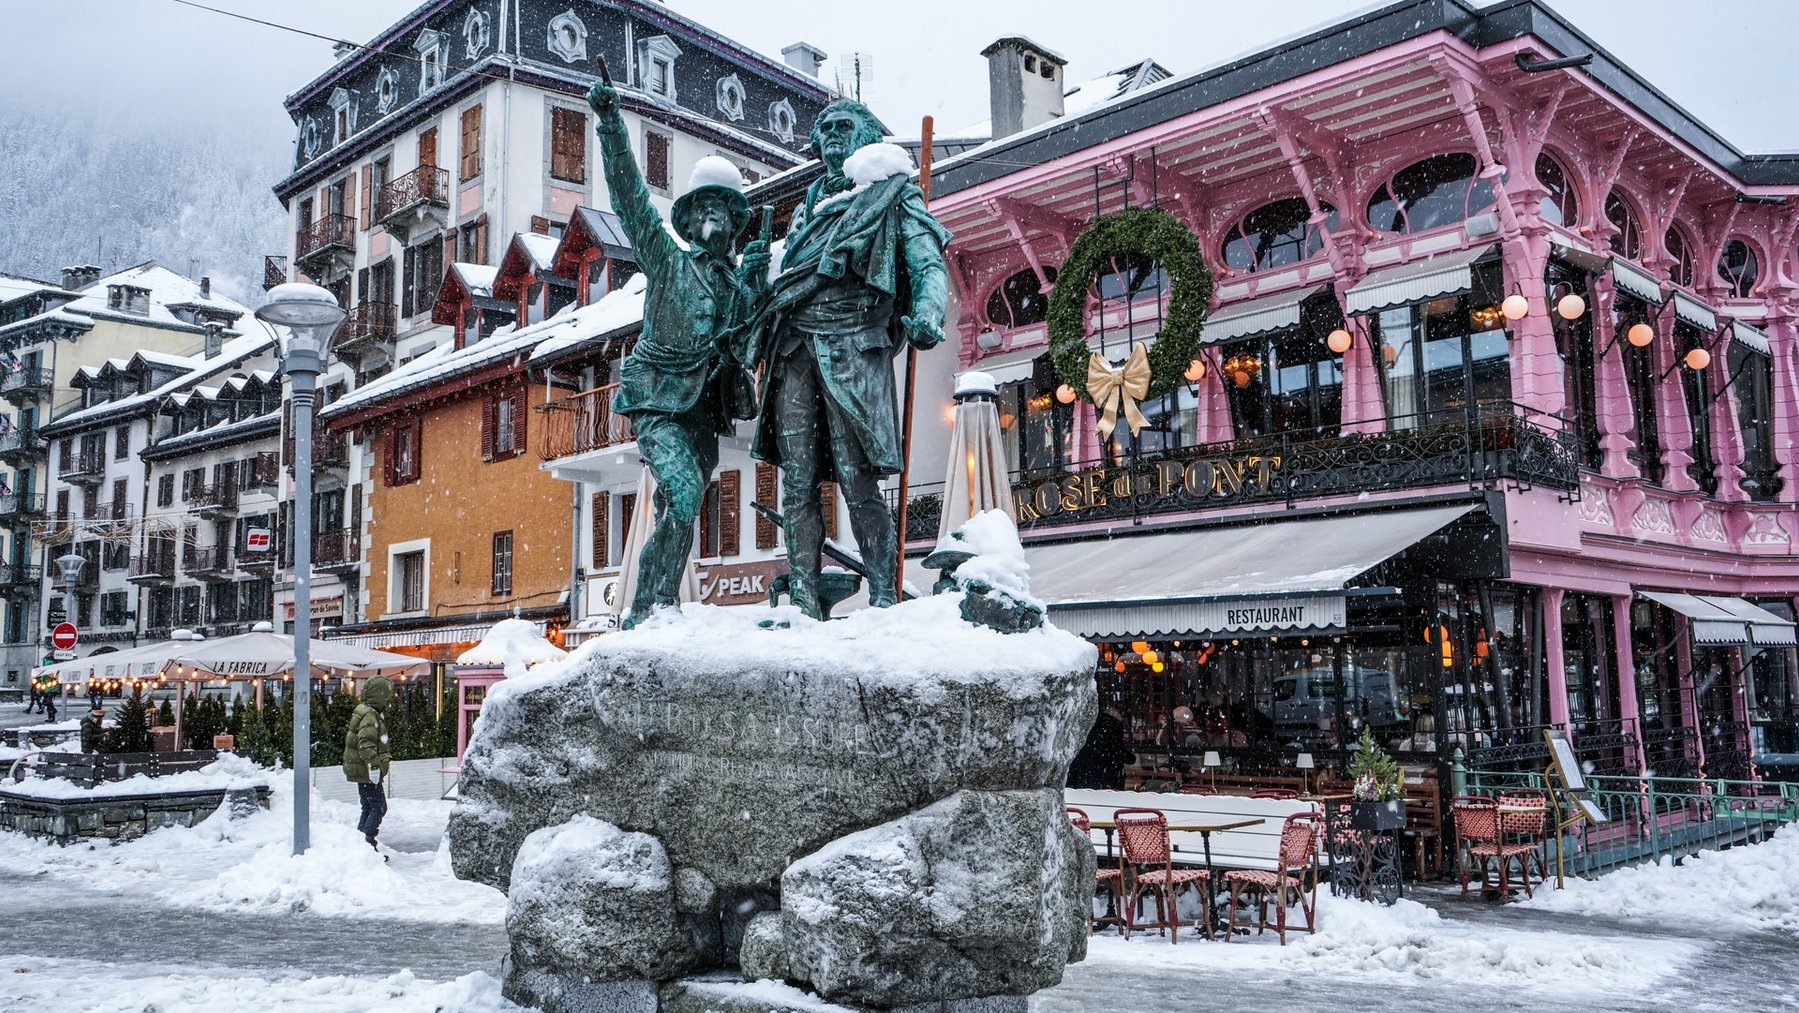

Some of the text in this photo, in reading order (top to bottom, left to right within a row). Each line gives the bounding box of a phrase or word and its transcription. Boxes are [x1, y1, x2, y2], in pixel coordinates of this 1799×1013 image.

[1013, 470, 1107, 523] ROSE
[1157, 456, 1281, 499] PONT
[718, 574, 765, 597] PEAK
[326, 604, 340, 612] Savoie
[1227, 606, 1305, 625] RESTAURANT
[212, 661, 268, 674] LA FABRICA
